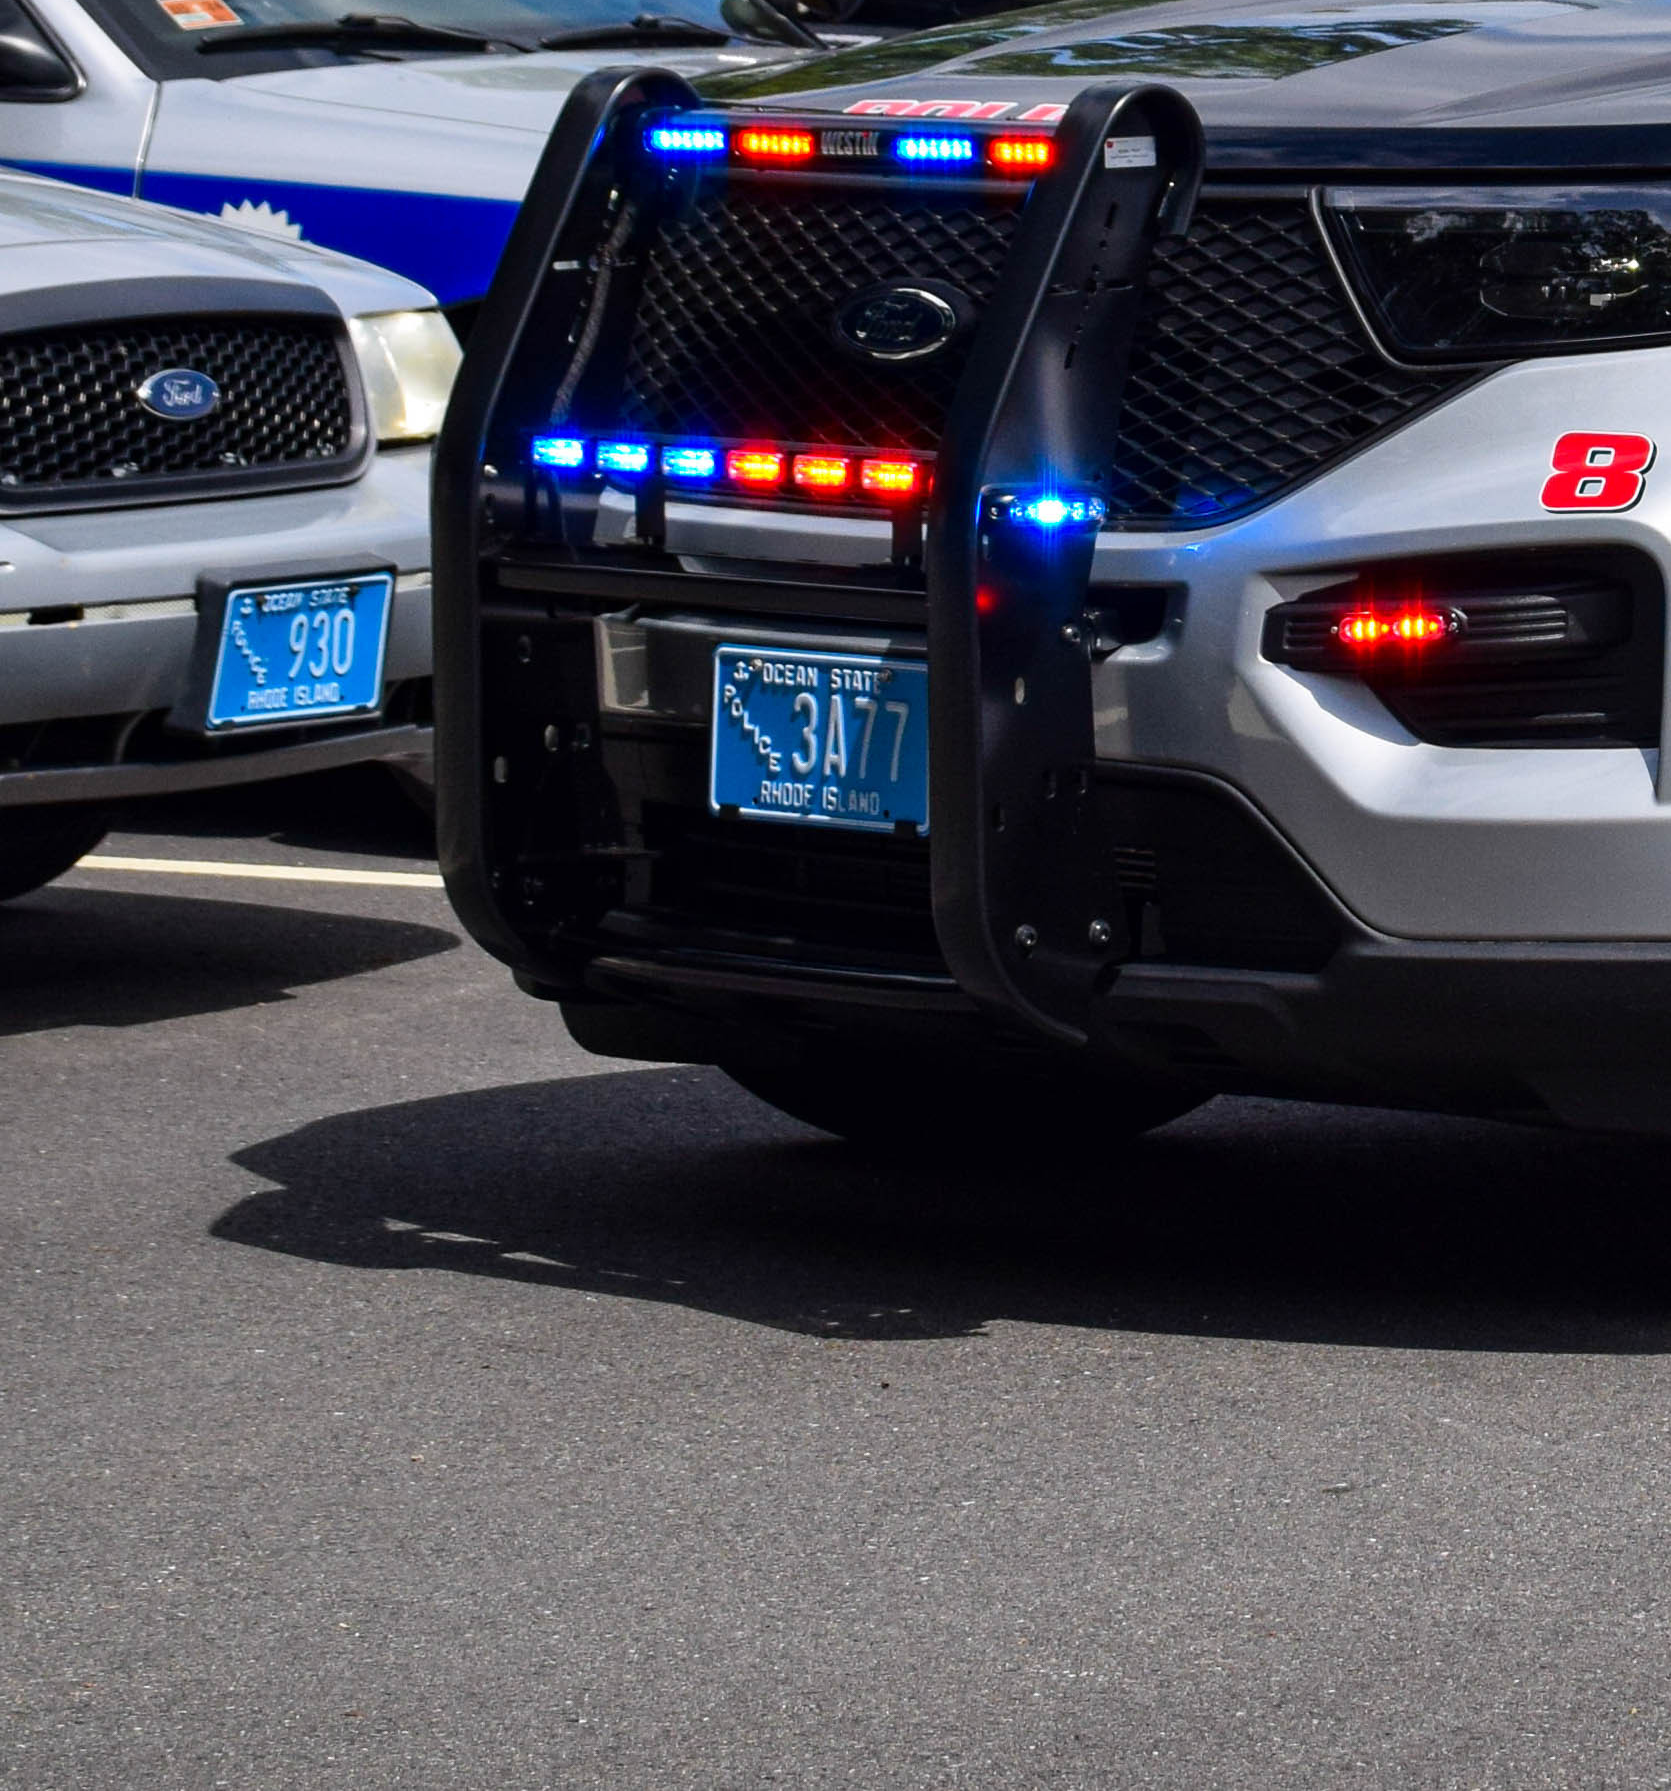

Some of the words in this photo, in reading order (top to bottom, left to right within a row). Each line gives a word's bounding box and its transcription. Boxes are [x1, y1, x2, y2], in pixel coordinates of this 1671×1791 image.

[162, 379, 203, 407] Ford
[1539, 430, 1657, 514] 8
[262, 593, 304, 613] OCEAN
[309, 587, 350, 607] STATE
[231, 620, 268, 685] POLICE
[289, 609, 354, 679] 930
[248, 687, 289, 710] RHODE
[293, 682, 340, 705] ISLAND
[762, 662, 819, 688] OCEAN
[830, 667, 882, 695] STATE
[723, 683, 783, 772] POLICE
[791, 692, 909, 783] 3A77
[760, 780, 815, 808] RHODE
[822, 785, 881, 816] ISLAND
